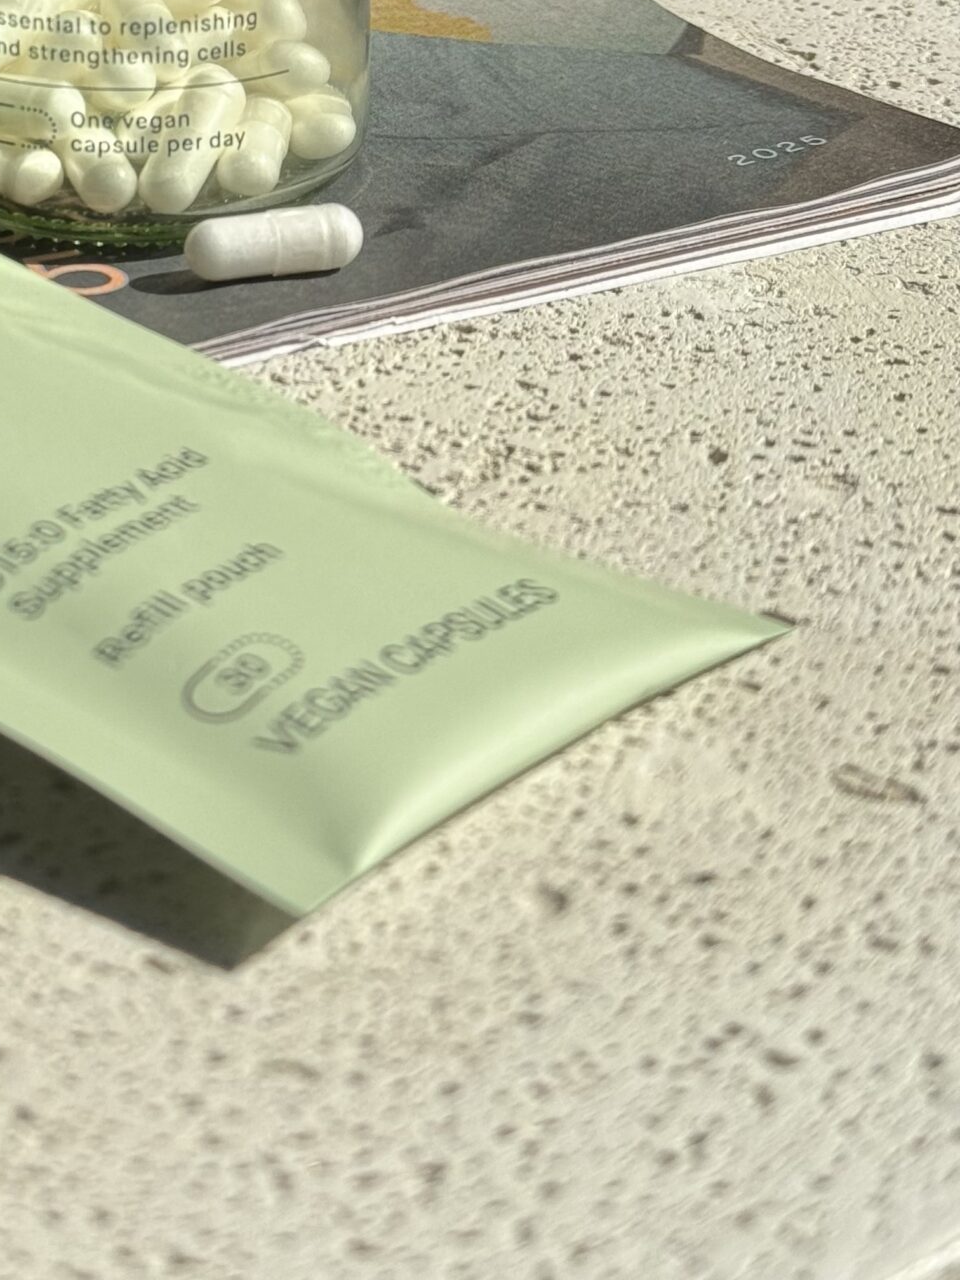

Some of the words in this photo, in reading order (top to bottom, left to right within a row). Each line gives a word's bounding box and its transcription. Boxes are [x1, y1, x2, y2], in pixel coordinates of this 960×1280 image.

[90, 18, 112, 36] to
[119, 11, 258, 40] replenishing
[28, 43, 190, 69] strengthening
[197, 39, 247, 61] cells
[70, 111, 114, 129] One
[119, 112, 190, 134] vegan
[70, 136, 159, 155] capsule
[167, 137, 203, 157] per
[209, 130, 246, 151] day
[727, 134, 828, 166] 2025
[55, 480, 148, 529] Fatty
[136, 446, 210, 489] Acid
[7, 494, 201, 621] Supplement
[93, 588, 190, 668] Refill
[179, 541, 285, 607] pouch
[251, 658, 397, 754] VEGAN
[378, 577, 560, 676] CAPSULES
